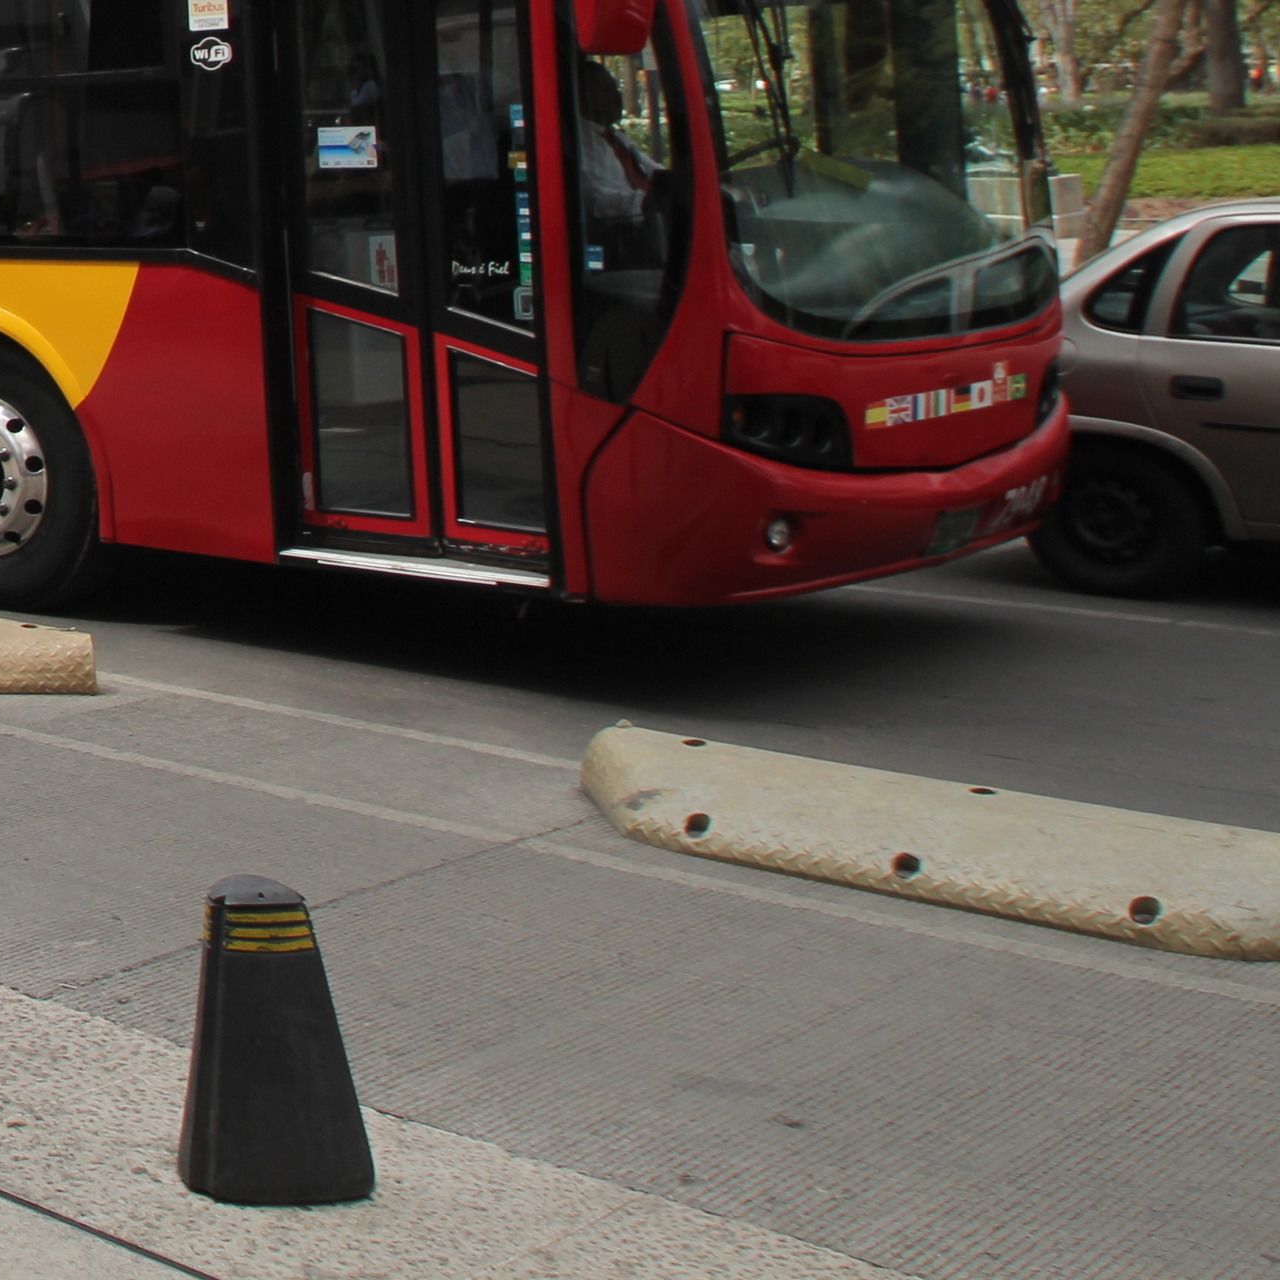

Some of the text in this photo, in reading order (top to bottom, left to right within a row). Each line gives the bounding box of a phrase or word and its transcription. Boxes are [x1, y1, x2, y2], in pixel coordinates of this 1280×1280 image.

[192, 2, 225, 13] Turibus
[451, 260, 476, 276] Deus
[487, 261, 510, 276] Fiel
